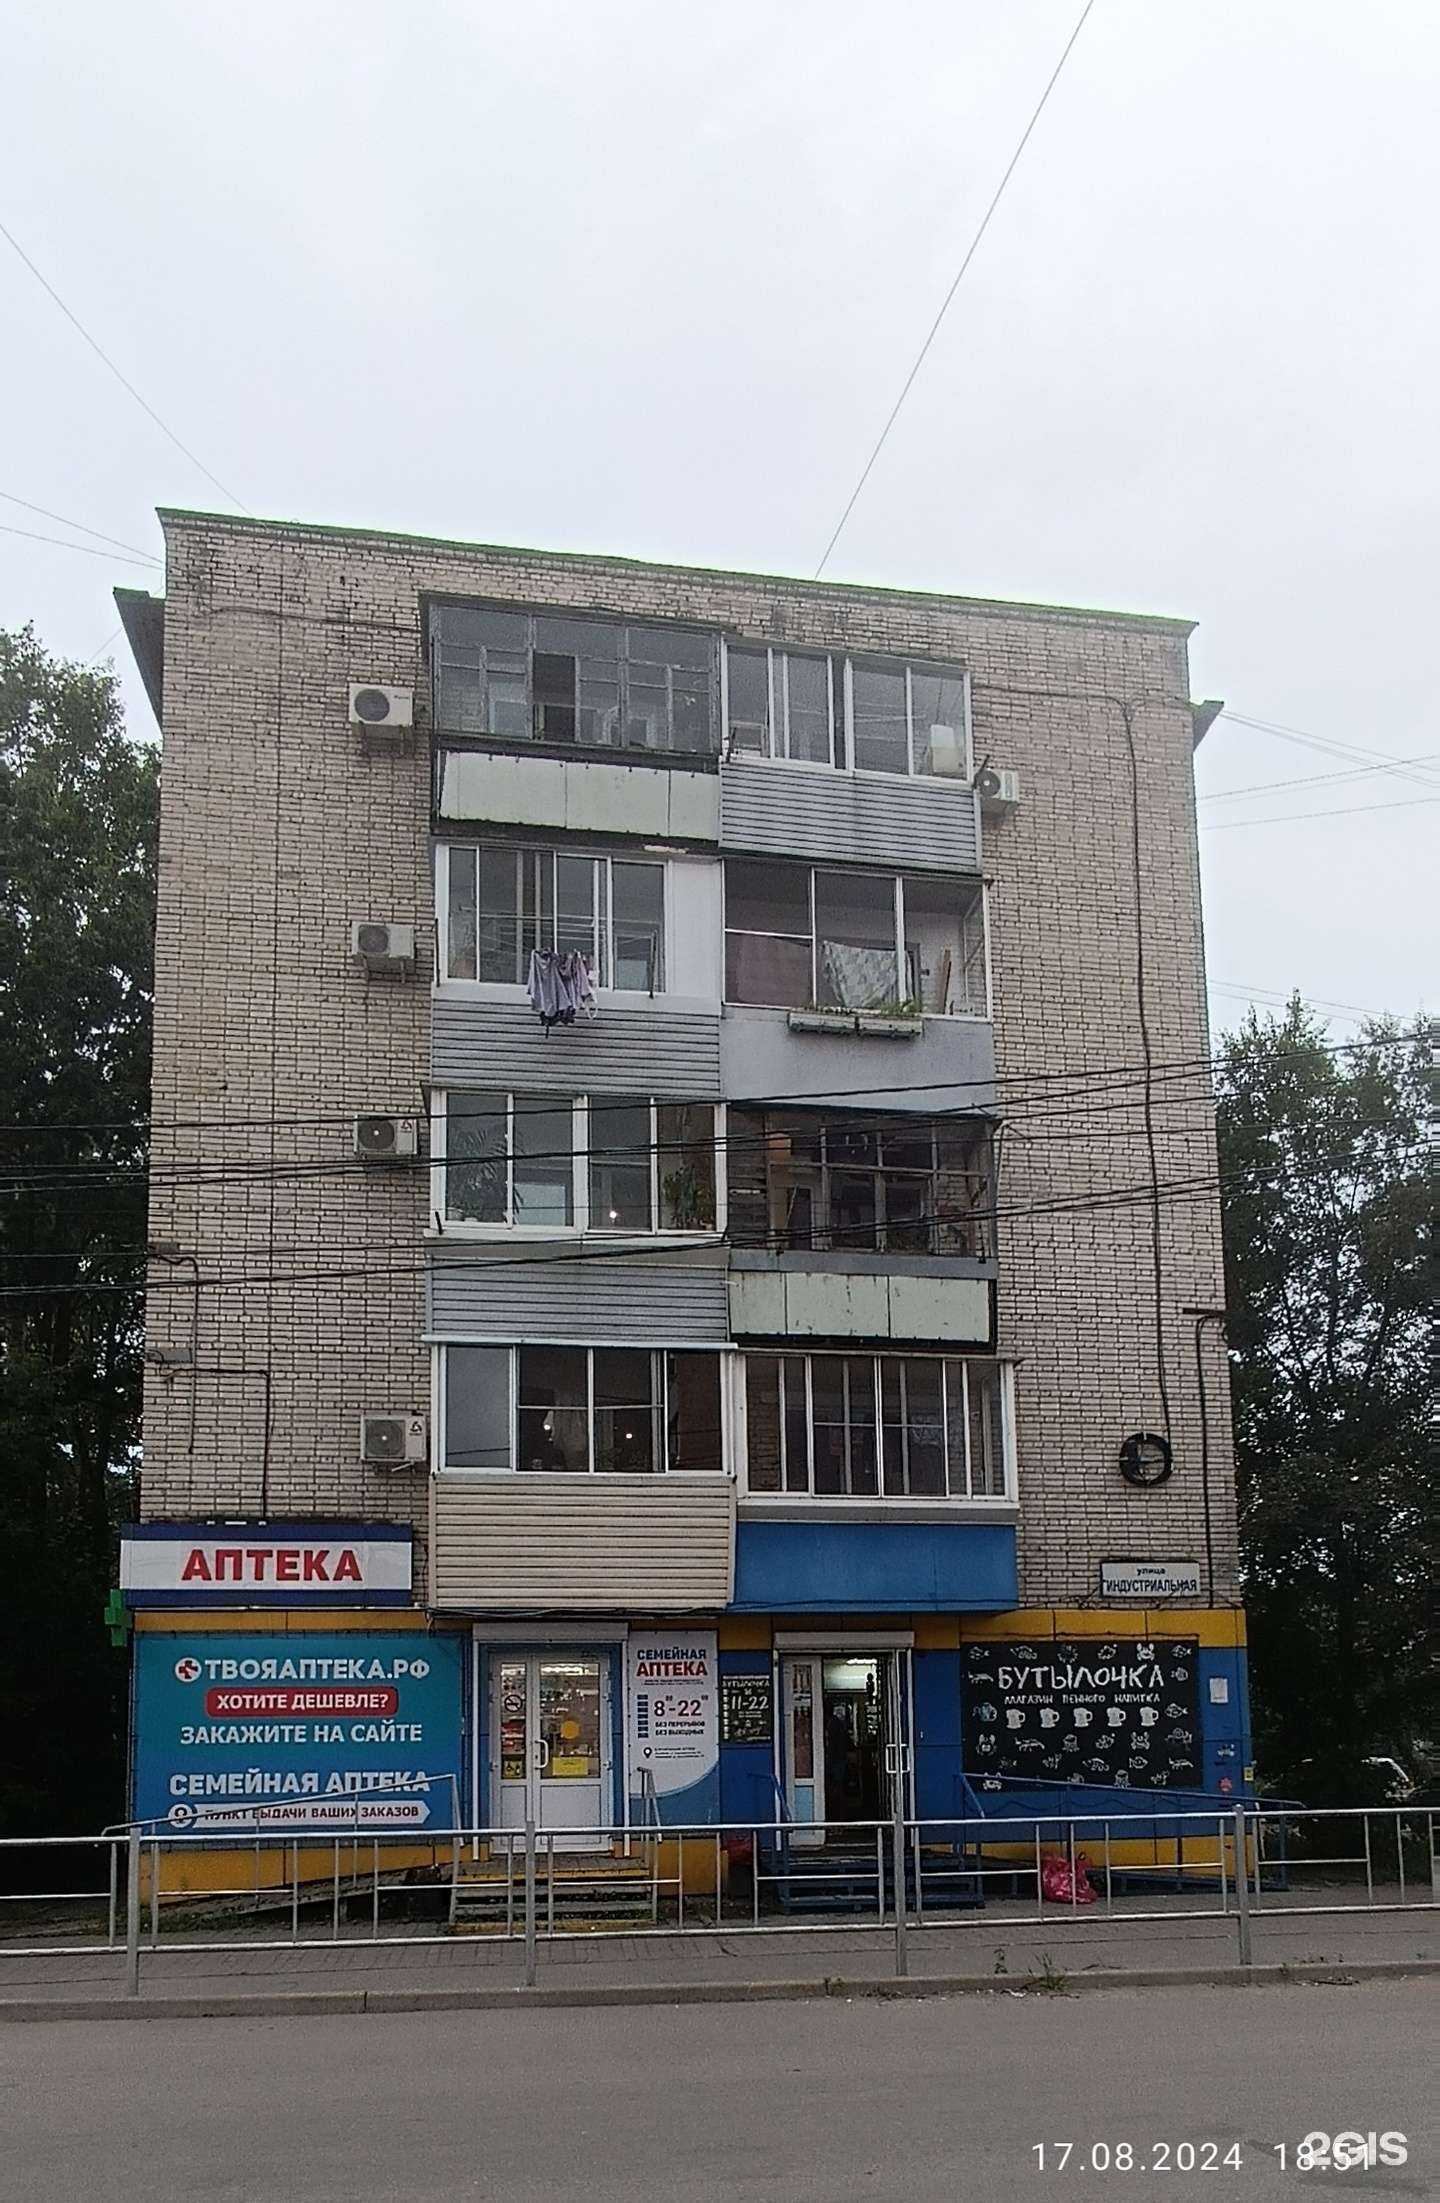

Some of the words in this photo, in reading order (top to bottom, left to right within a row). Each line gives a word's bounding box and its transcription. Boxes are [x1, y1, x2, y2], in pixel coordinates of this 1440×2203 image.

[181, 1549, 363, 1581] АПТЕКА
[1136, 1566, 1166, 1575] улица
[1106, 1578, 1197, 1592] ИНДУСТРИАЛЬНАЯ
[637, 1646, 707, 1660] СЕМЕЙНАЯ
[205, 1658, 431, 1680] ТВОЯАПТЕКА.РФ
[636, 1661, 708, 1677] АПТЕКА
[998, 1664, 1165, 1690] БУТЫЛОЧКА
[217, 1693, 288, 1709] ХОТИТЕ
[291, 1692, 389, 1711] ДЕШЕВЛЕ?
[731, 1696, 769, 1710] 11-22
[1004, 1694, 1054, 1705] МАГАЗИН
[1114, 1693, 1160, 1703] НАПИТКА
[180, 1725, 307, 1745] ЗАКАЖИТЕ
[314, 1725, 344, 1743] НА
[351, 1719, 423, 1742] САЙТЕ
[169, 1768, 319, 1797] СЕМЕЙНАЯ
[325, 1771, 431, 1794] АПТЕКА
[361, 1806, 419, 1818] ЗАКАЗОВ
